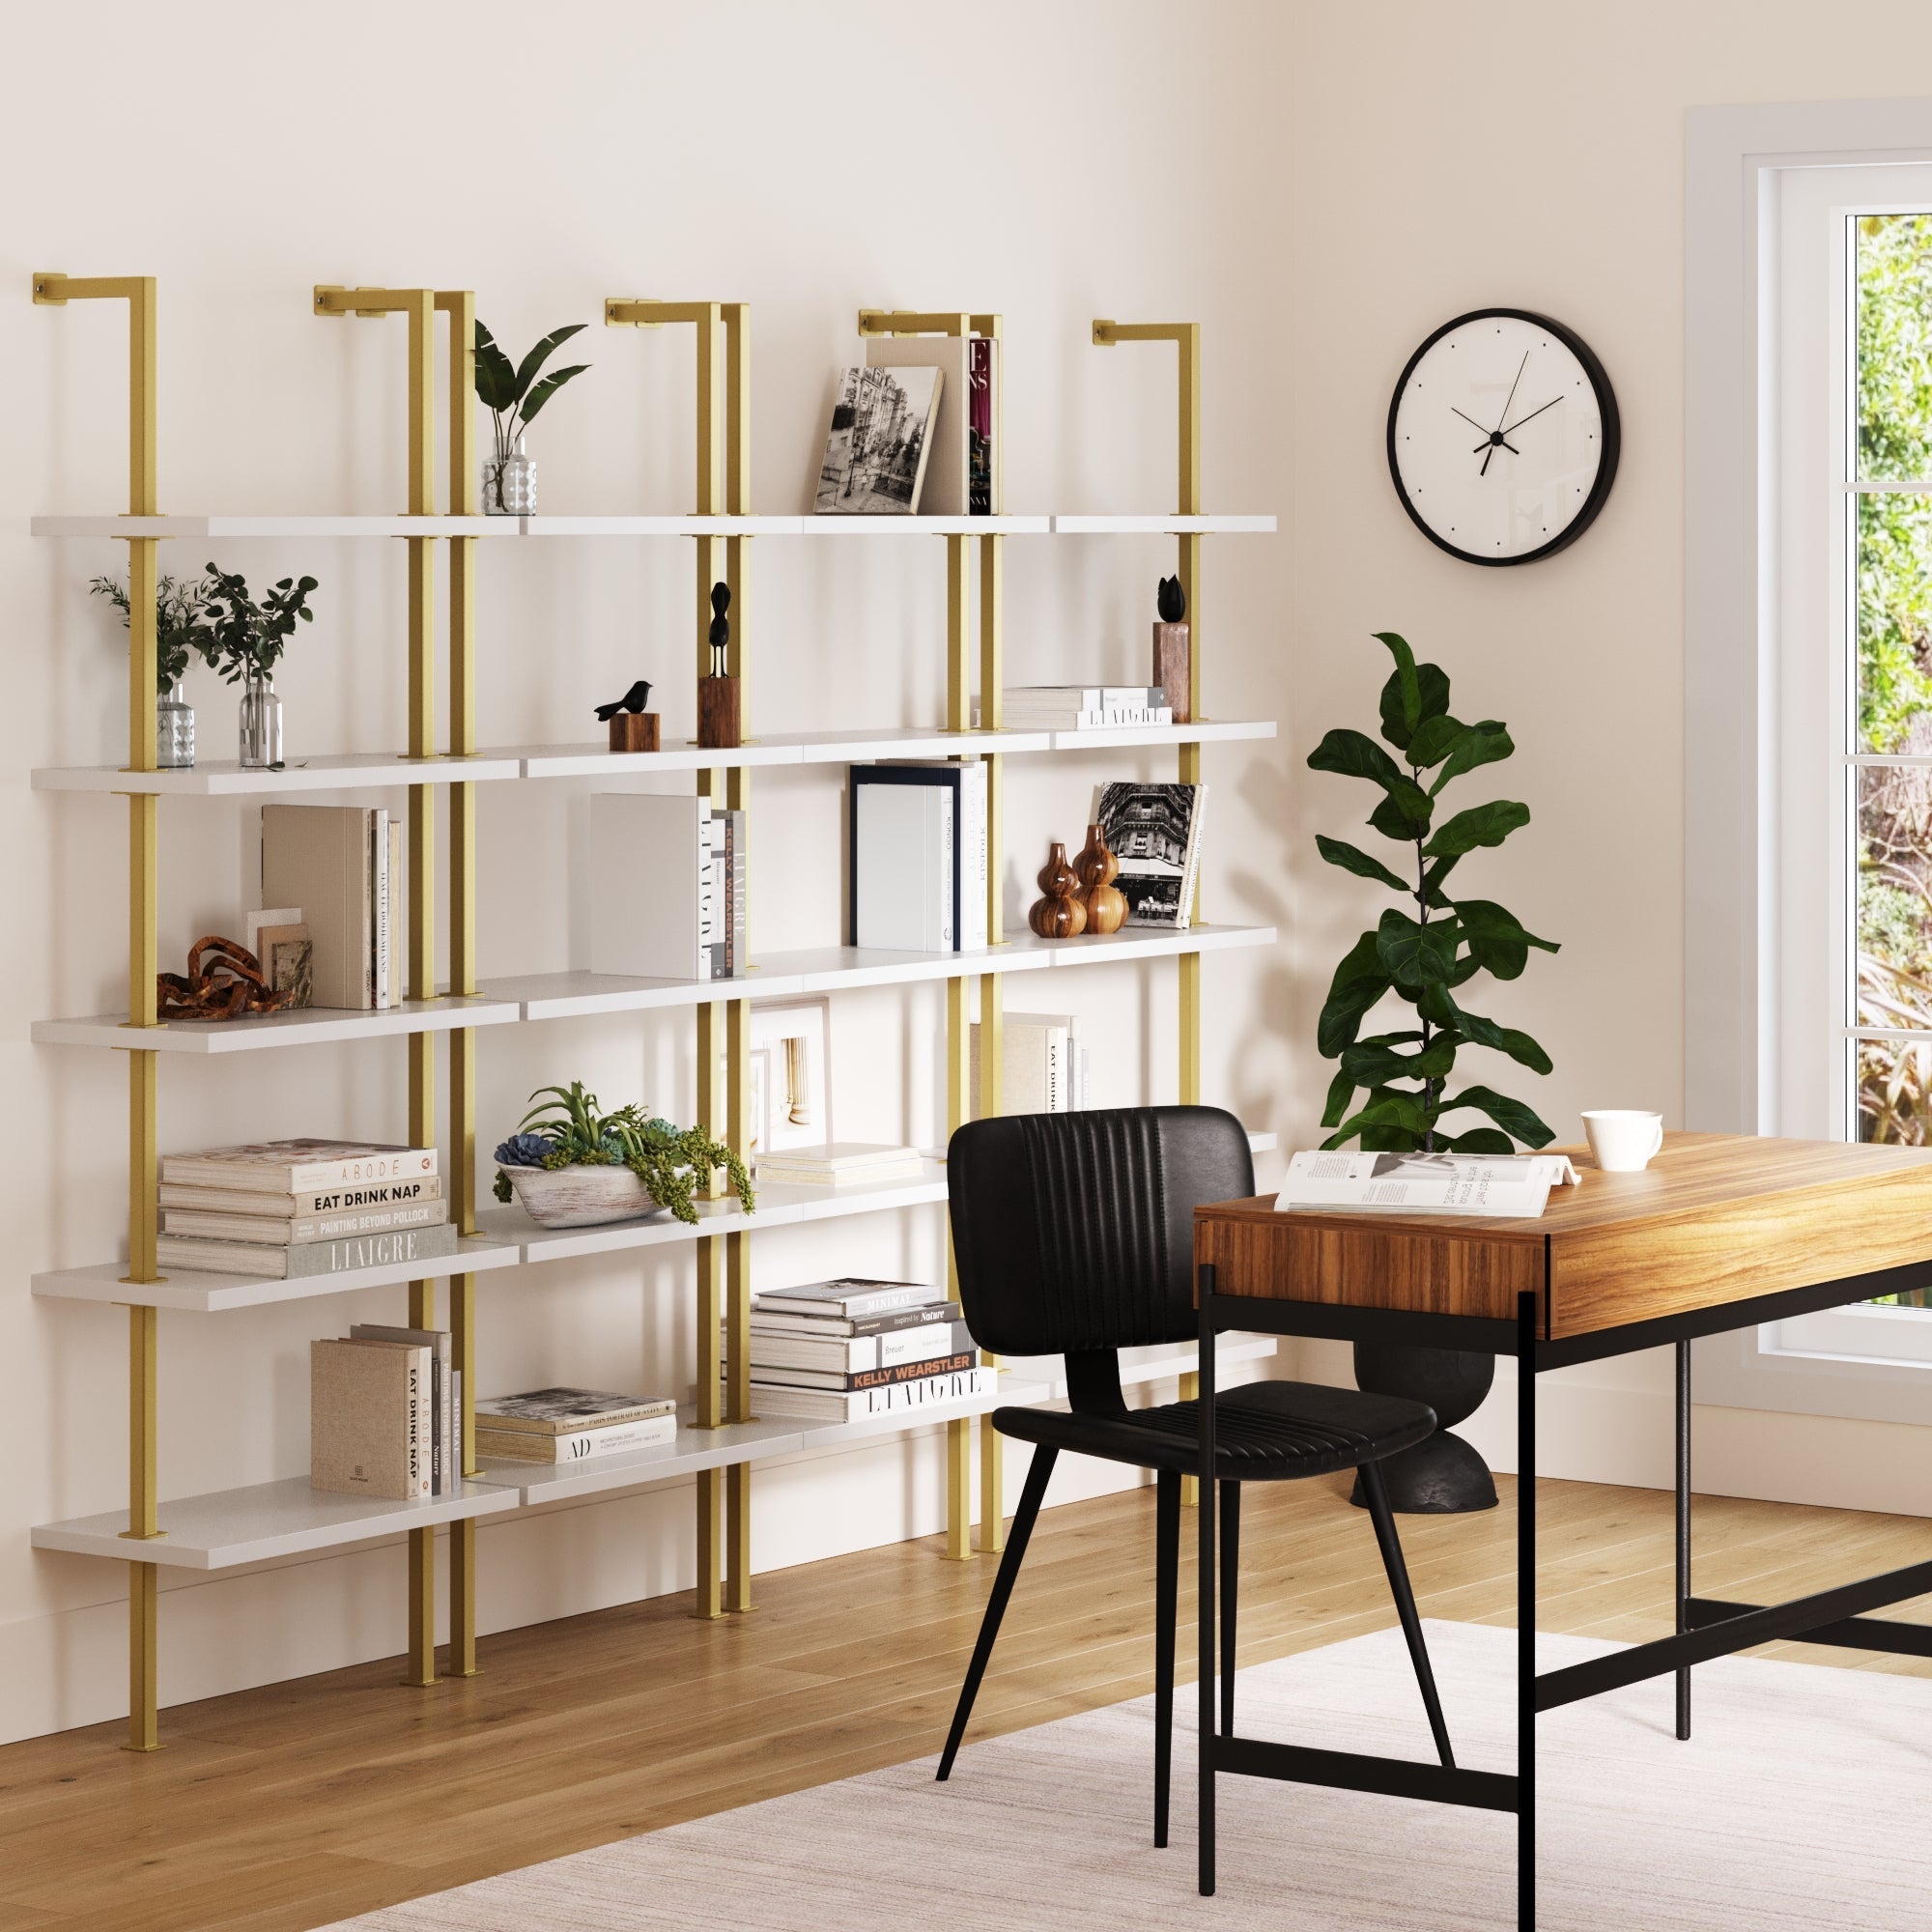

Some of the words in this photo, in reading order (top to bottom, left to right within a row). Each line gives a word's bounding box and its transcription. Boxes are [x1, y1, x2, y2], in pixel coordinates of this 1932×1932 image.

[734, 852, 745, 936] LIAIGRE
[342, 1159, 400, 1183] ABODE
[315, 1195, 340, 1210] EAT
[345, 1188, 388, 1207] DRINK
[392, 1184, 421, 1200] NAP
[321, 1220, 357, 1235] PAINTING
[359, 1215, 392, 1230] BEYOND
[393, 1208, 430, 1224] POLLOCK
[331, 1233, 417, 1271] LIAIGRE
[867, 1294, 912, 1311] MINIMAL
[921, 1310, 945, 1322] Nature
[854, 1369, 892, 1388] KELLY
[895, 1354, 970, 1380] WEARSTLER
